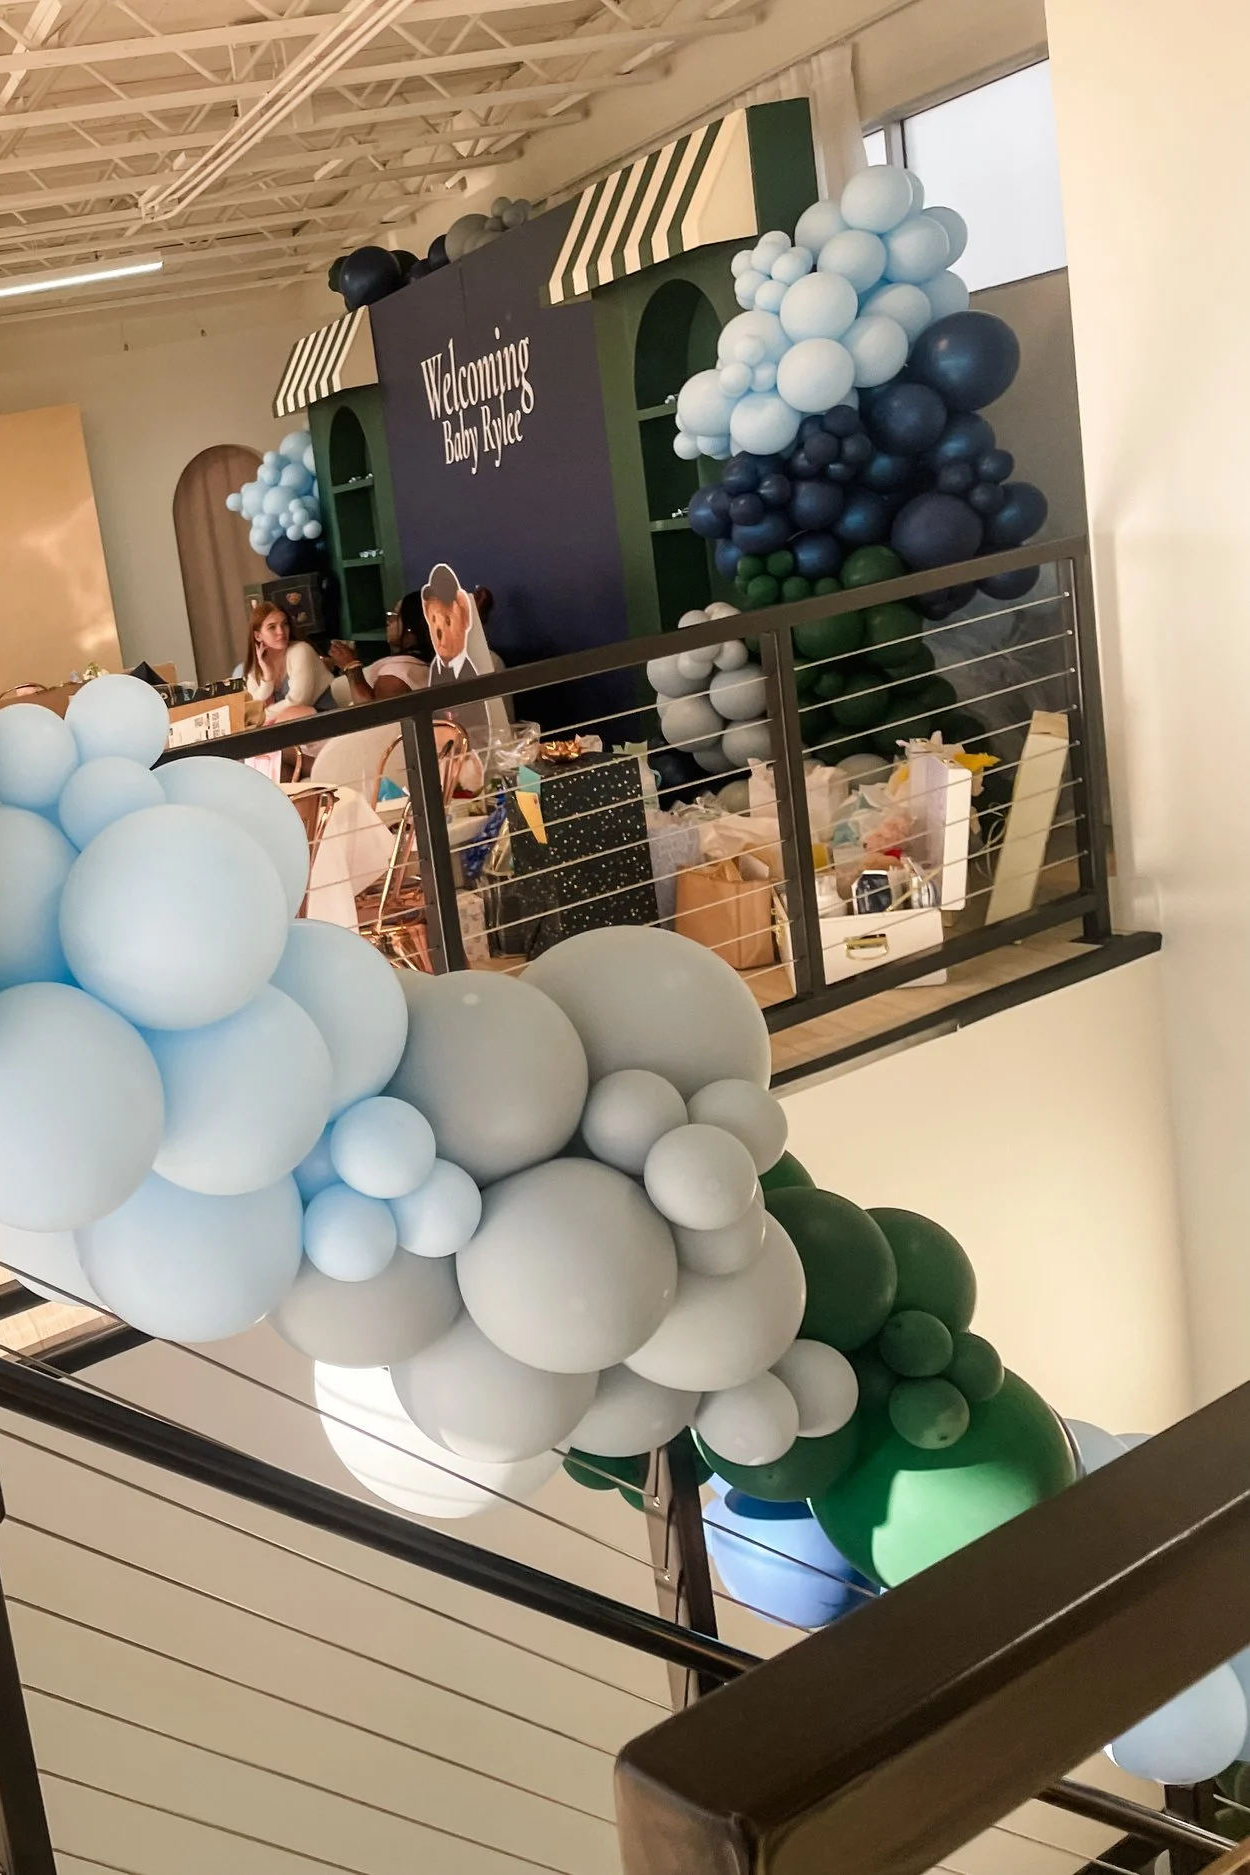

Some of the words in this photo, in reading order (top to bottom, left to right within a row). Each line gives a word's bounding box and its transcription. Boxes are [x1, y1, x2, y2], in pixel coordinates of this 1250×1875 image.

[420, 326, 535, 420] Welcoming
[442, 408, 479, 475] Baby
[480, 395, 524, 468] Rylee
